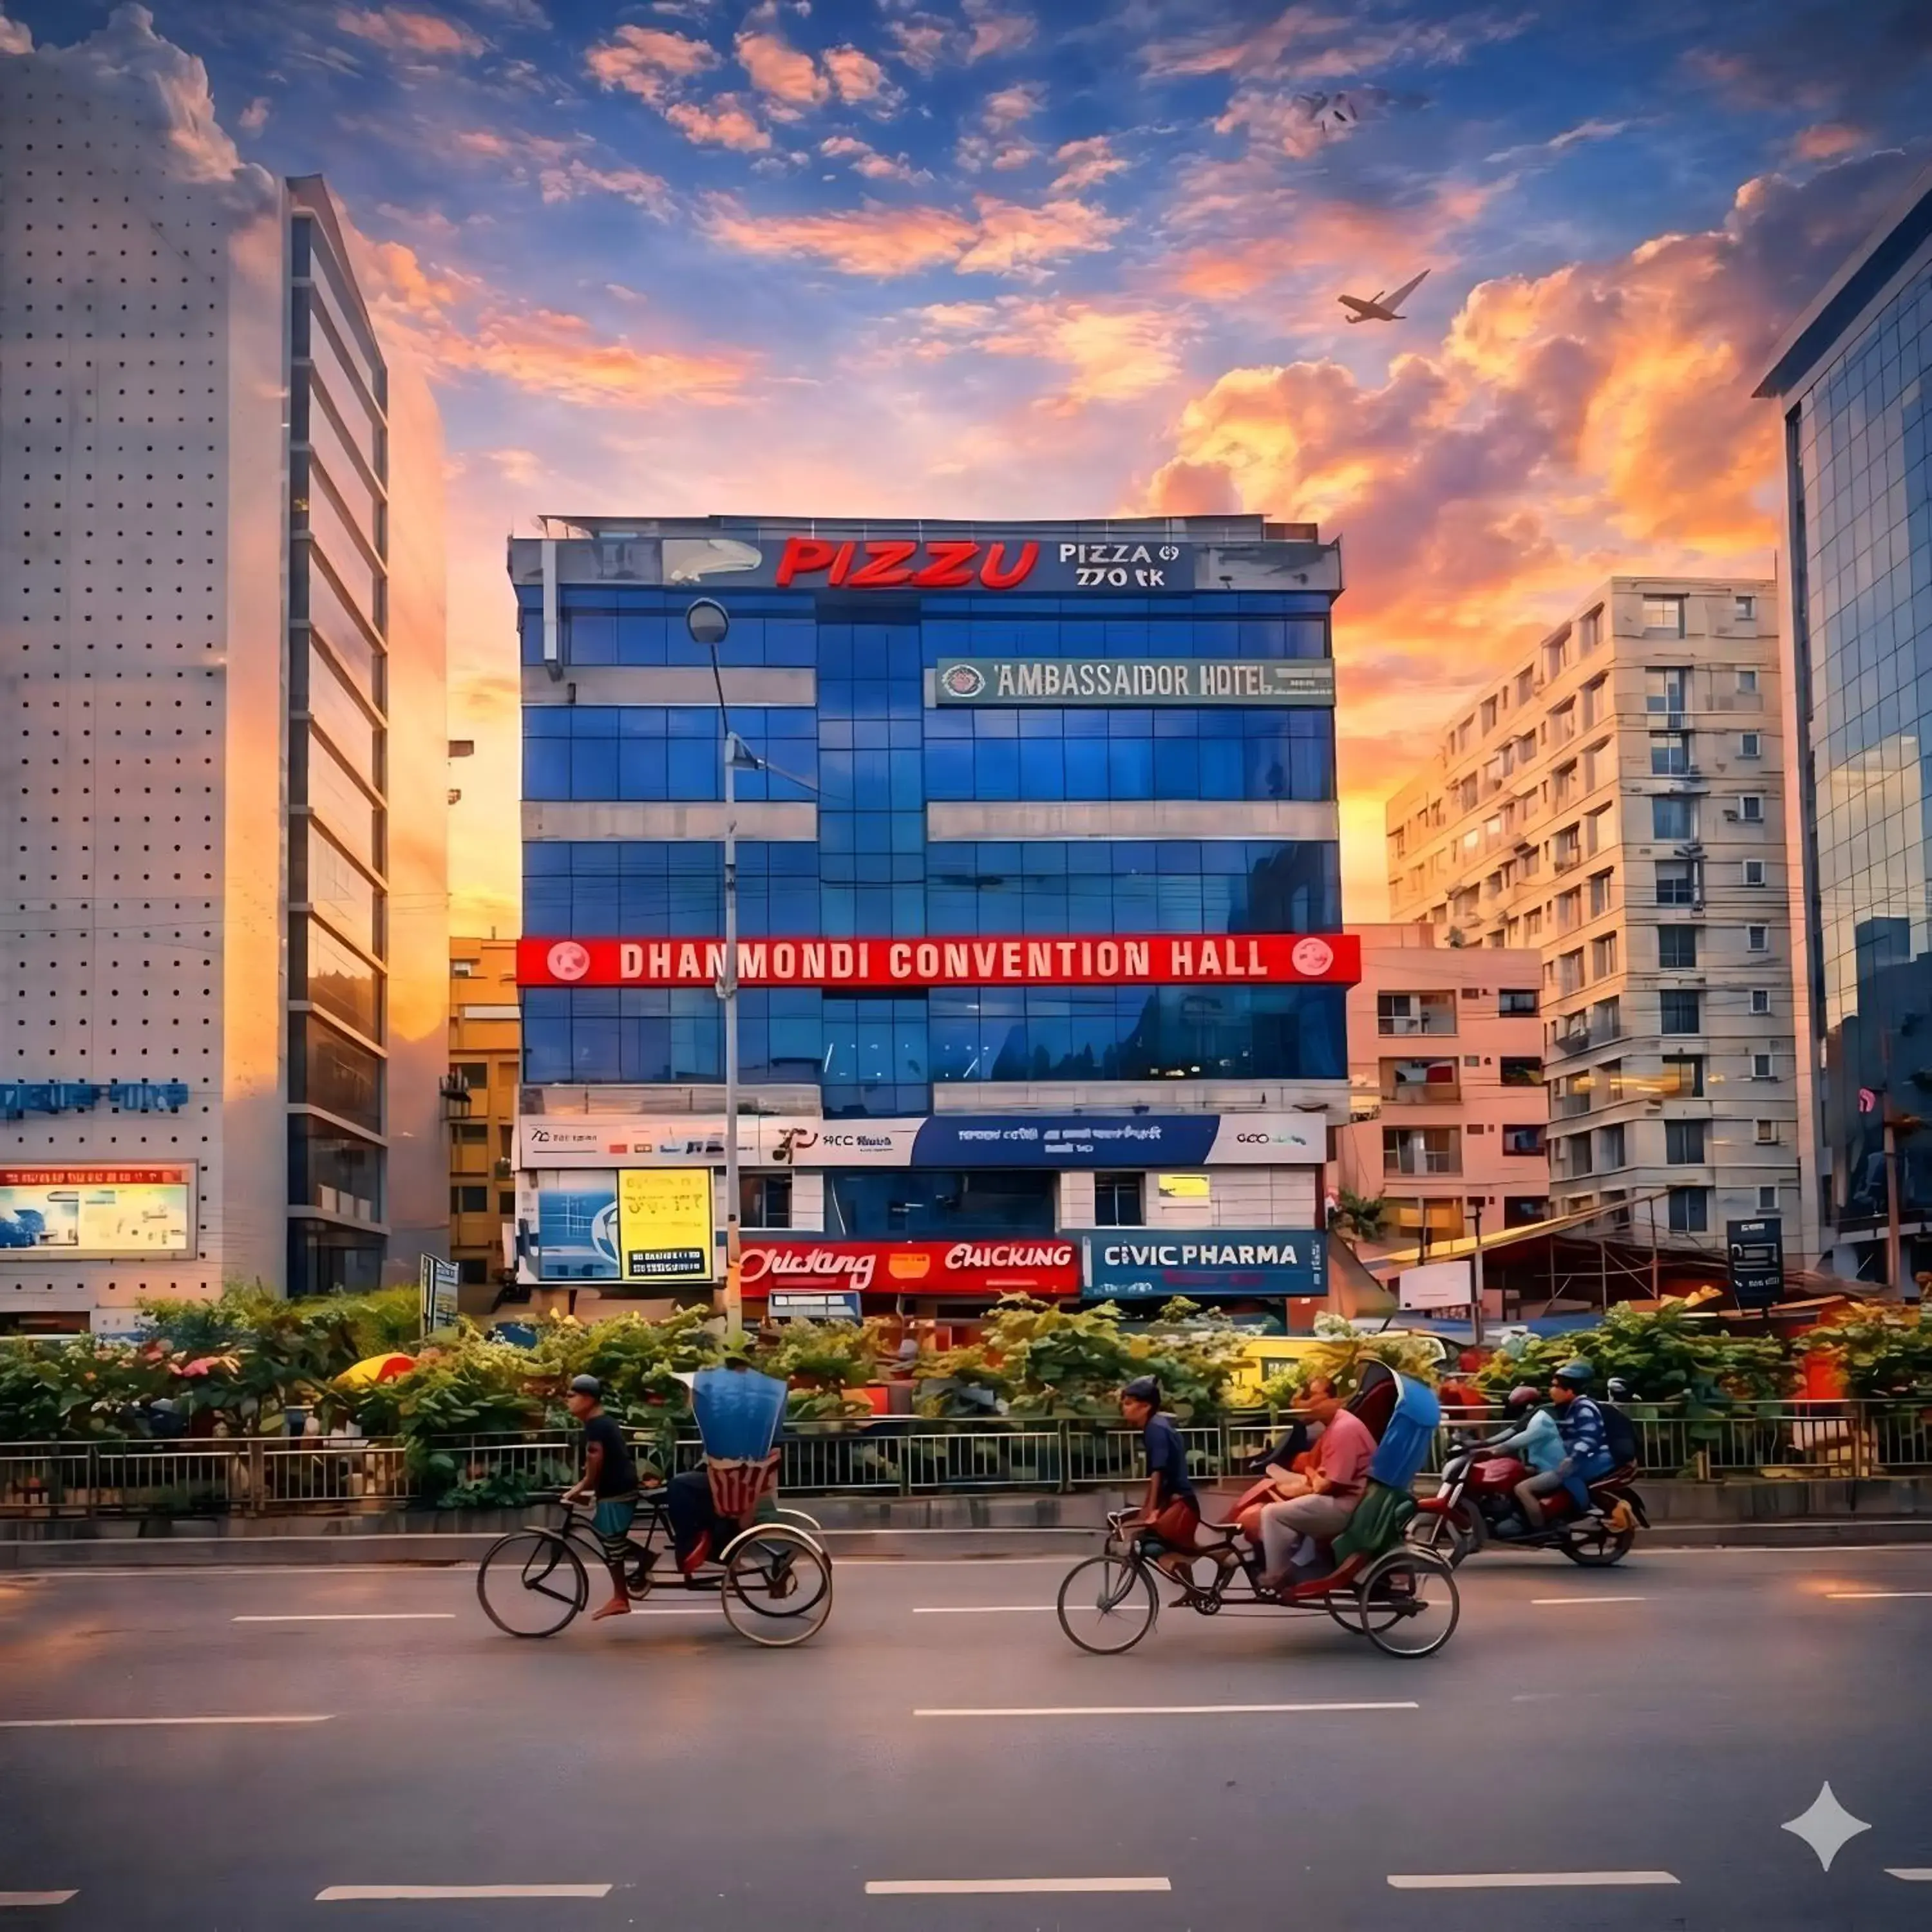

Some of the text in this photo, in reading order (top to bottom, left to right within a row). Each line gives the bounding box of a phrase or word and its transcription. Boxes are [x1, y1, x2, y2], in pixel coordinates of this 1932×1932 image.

[776, 538, 1039, 589] PIZZU
[1059, 543, 1152, 564] PIZZA
[1200, 665, 1268, 696] HOTEL
[620, 940, 1268, 979] DHANMONDI CONVENTION HALL
[1104, 1243, 1179, 1265] CIVIC
[1182, 1245, 1298, 1265] PHARMA
